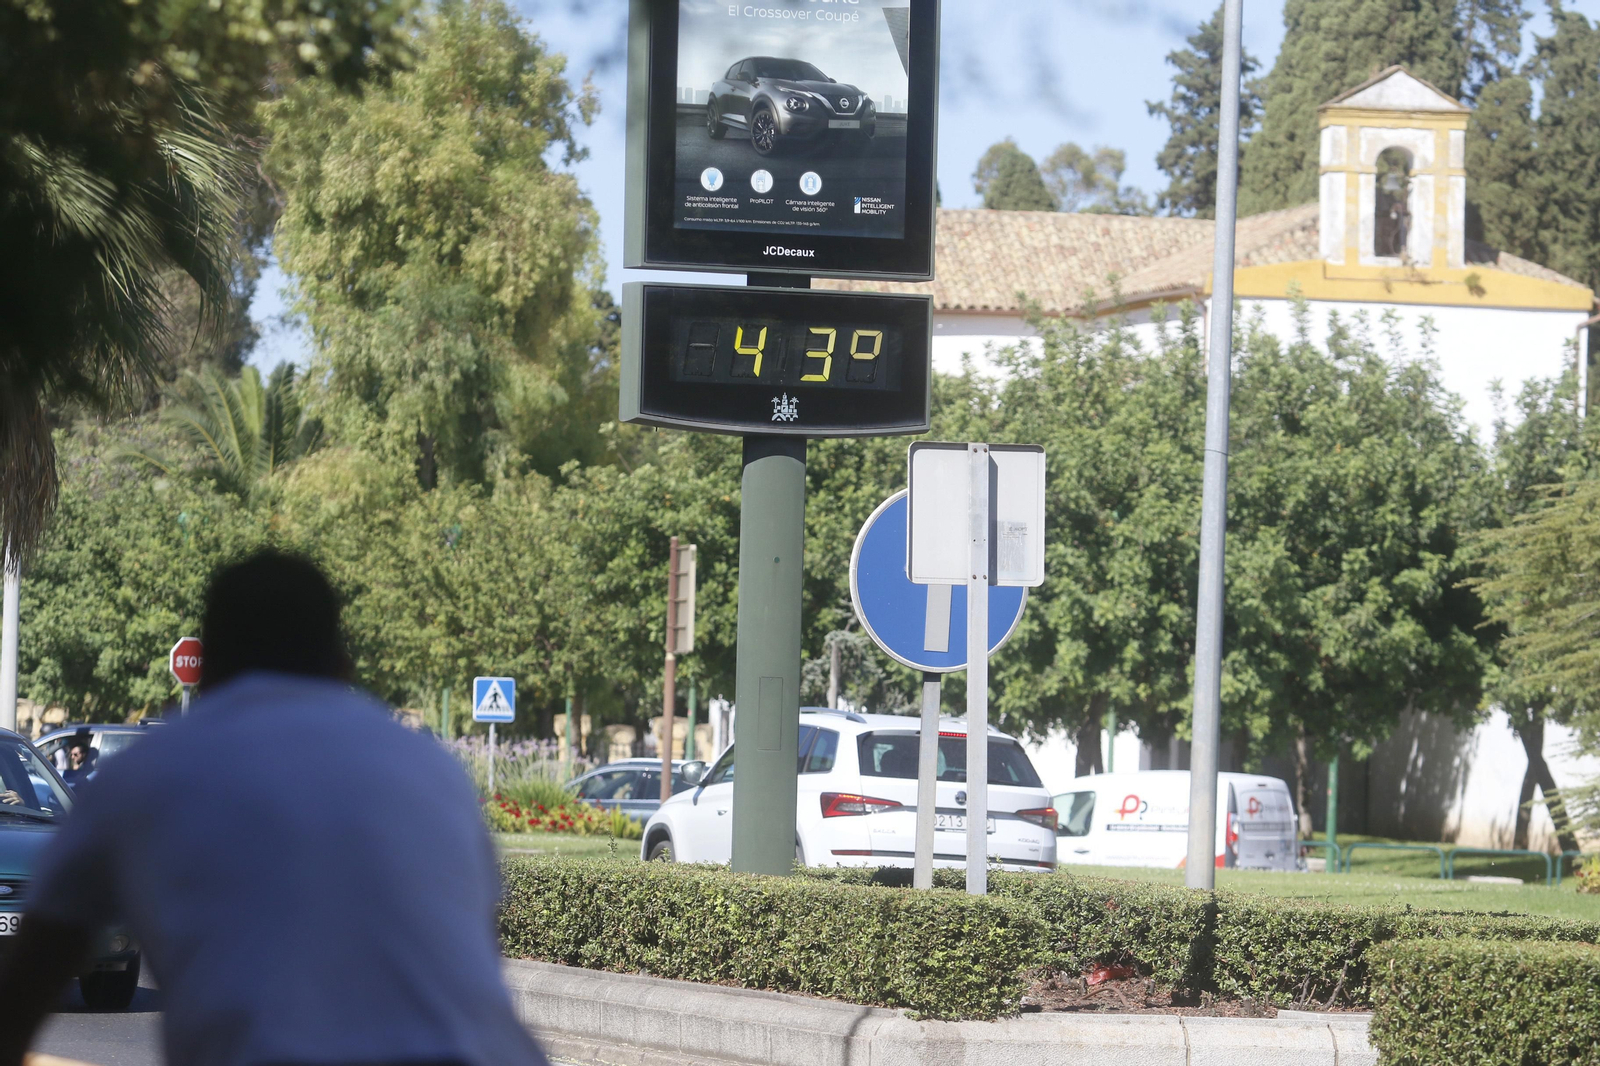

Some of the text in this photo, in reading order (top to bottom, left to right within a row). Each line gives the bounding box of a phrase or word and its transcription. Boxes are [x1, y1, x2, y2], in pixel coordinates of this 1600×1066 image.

[728, 5, 860, 24] El Crossover Coupé
[709, 196, 738, 205] inteligente
[762, 245, 815, 258] JCDecaux
